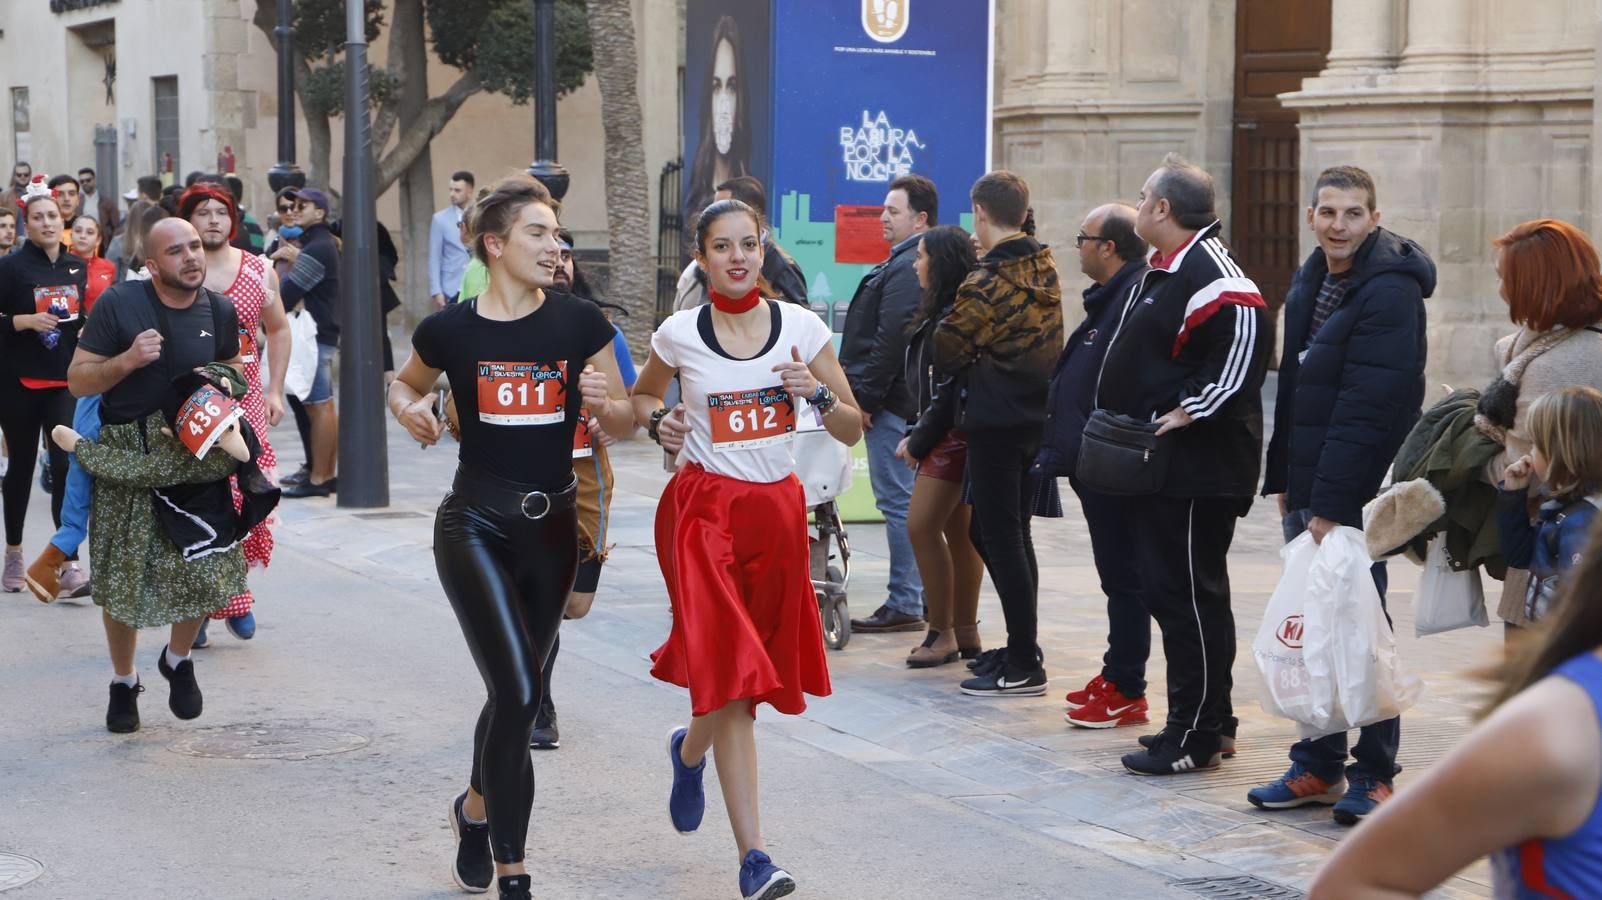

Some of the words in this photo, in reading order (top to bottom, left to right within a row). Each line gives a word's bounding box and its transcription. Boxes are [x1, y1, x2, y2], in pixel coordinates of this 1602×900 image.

[862, 109, 892, 129] LA
[844, 144, 881, 163] POR
[887, 144, 915, 164] LA
[846, 162, 912, 181] NOCHE
[497, 382, 545, 406] 611
[723, 398, 753, 406] SILVESTRE
[188, 401, 221, 436] 436
[728, 406, 778, 433] 612
